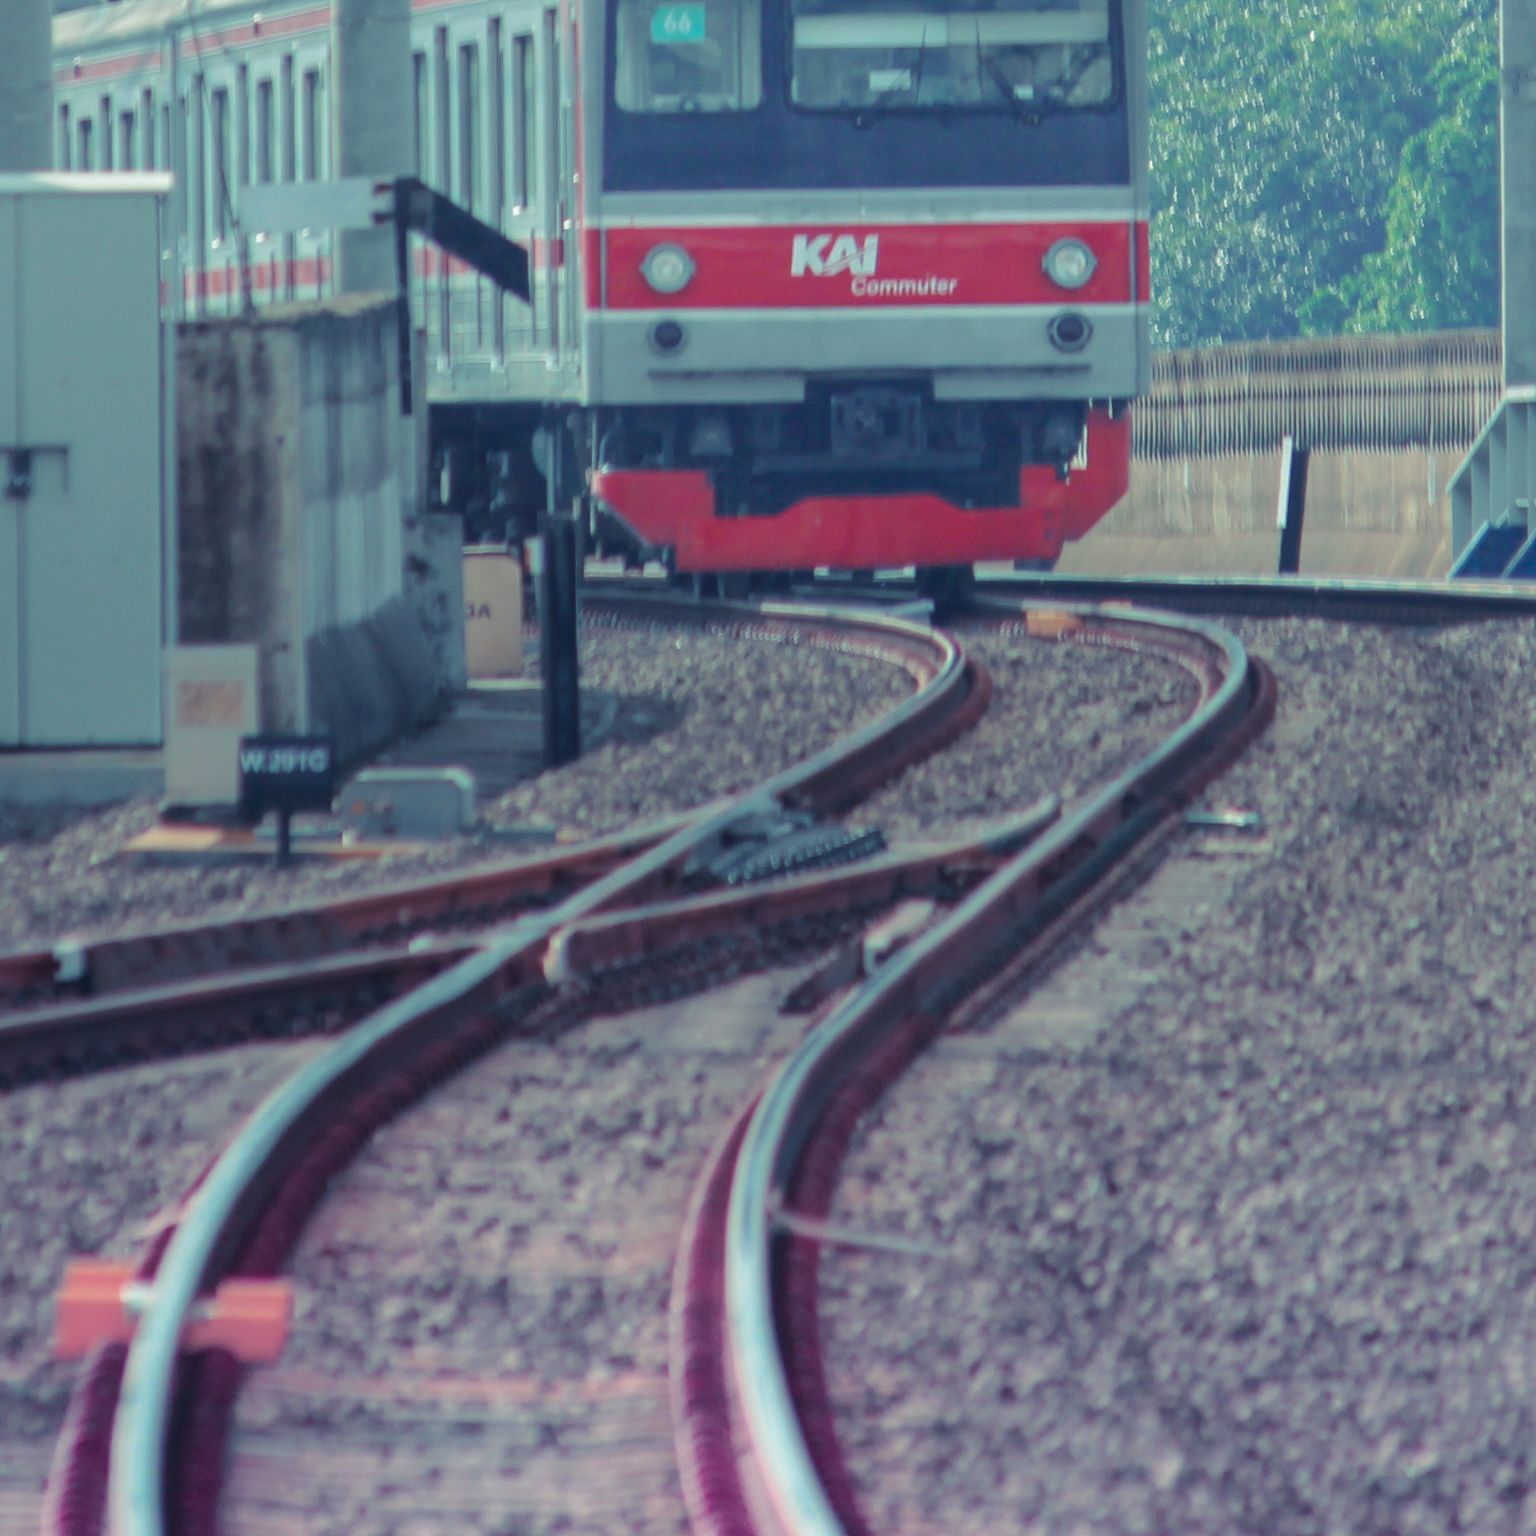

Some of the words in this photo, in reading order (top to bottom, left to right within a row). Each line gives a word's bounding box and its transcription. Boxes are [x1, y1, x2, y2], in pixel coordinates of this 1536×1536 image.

[663, 10, 691, 33] 66
[791, 233, 879, 277] KAI
[851, 274, 958, 297] Commuter
